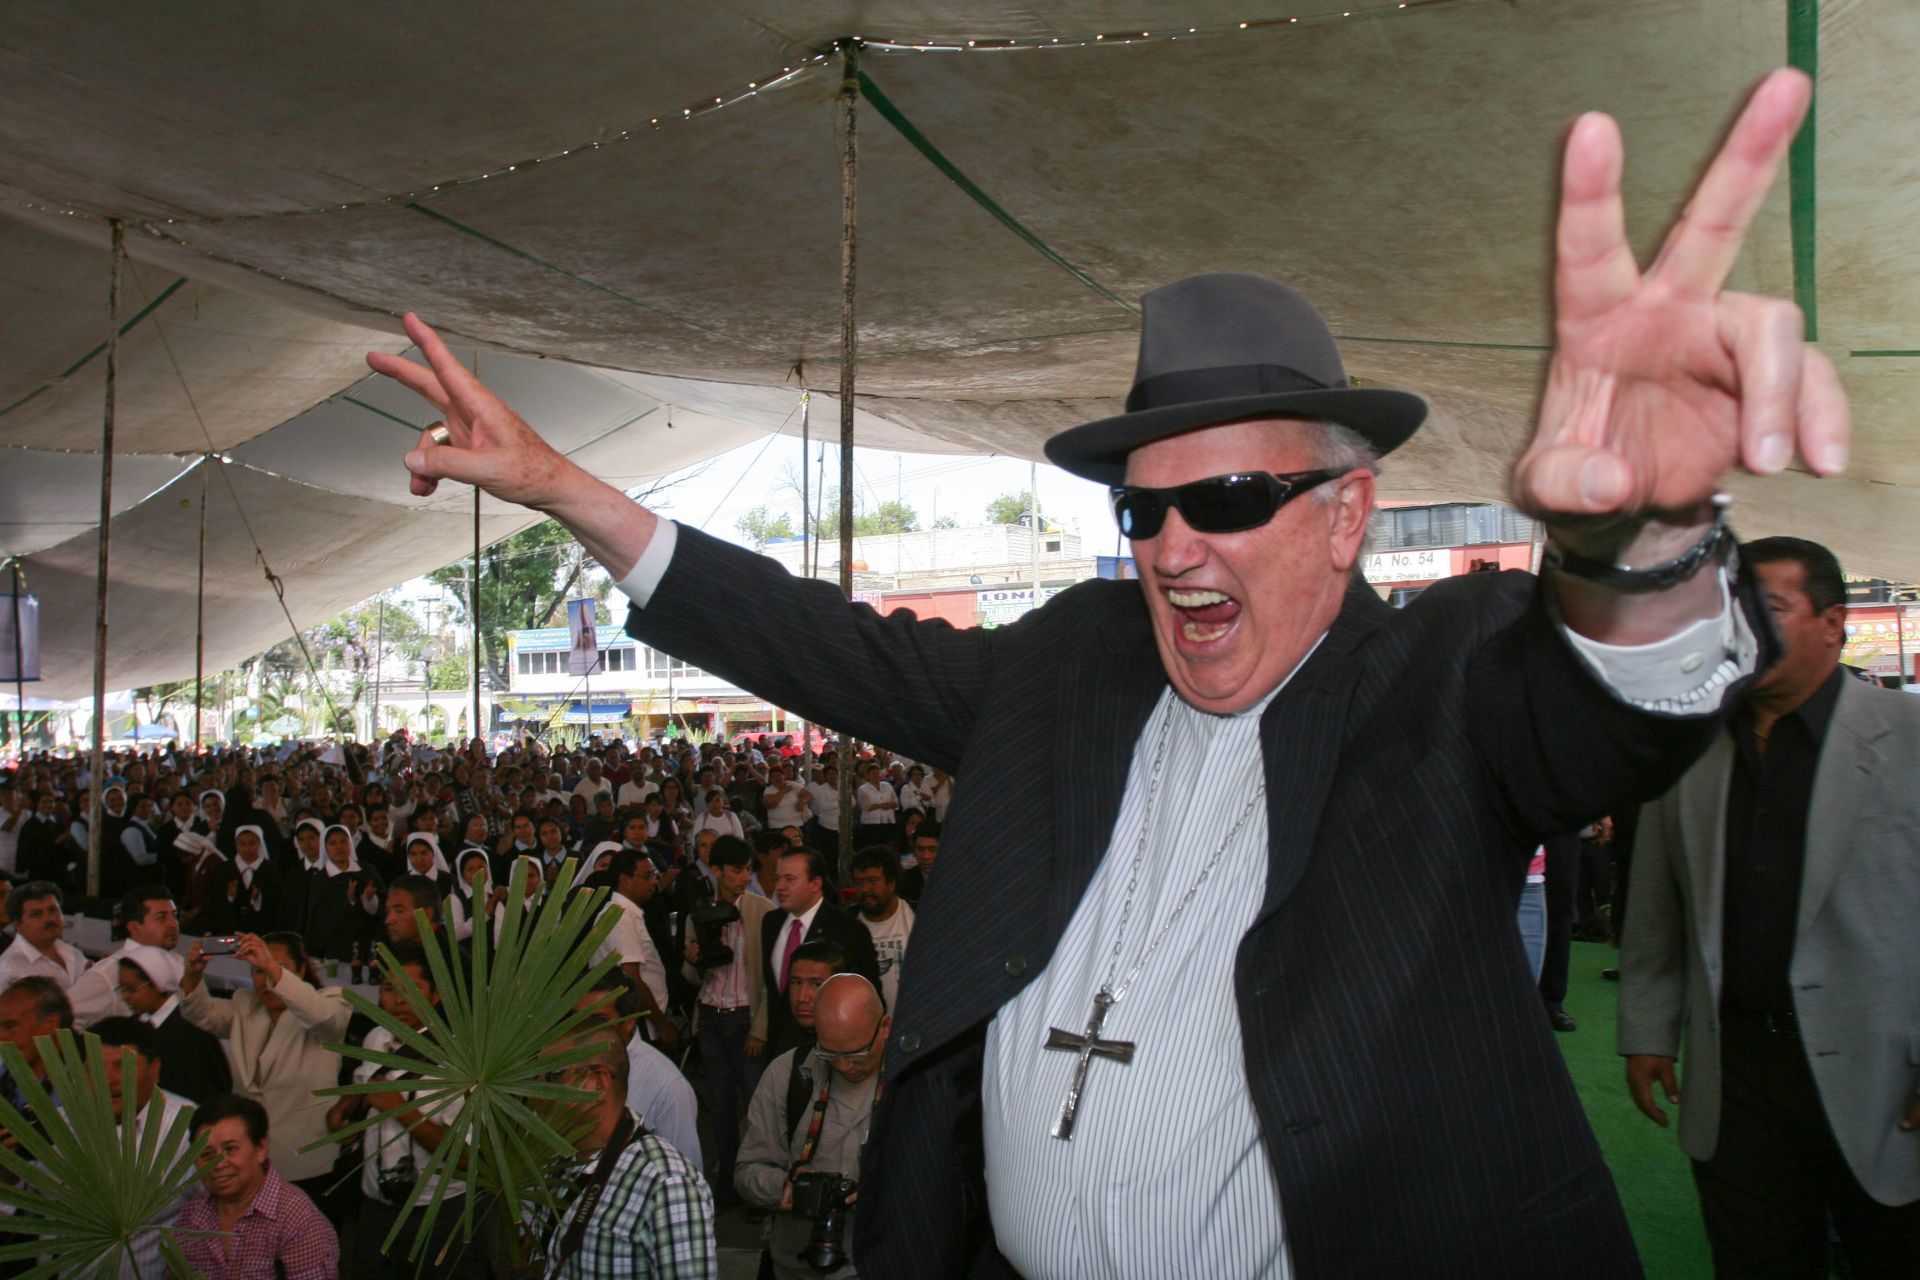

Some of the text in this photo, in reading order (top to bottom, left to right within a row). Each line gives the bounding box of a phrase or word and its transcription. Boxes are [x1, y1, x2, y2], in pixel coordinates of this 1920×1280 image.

[1391, 553, 1412, 566] No.
[1418, 552, 1434, 564] 54
[575, 1183, 601, 1223] Canon
